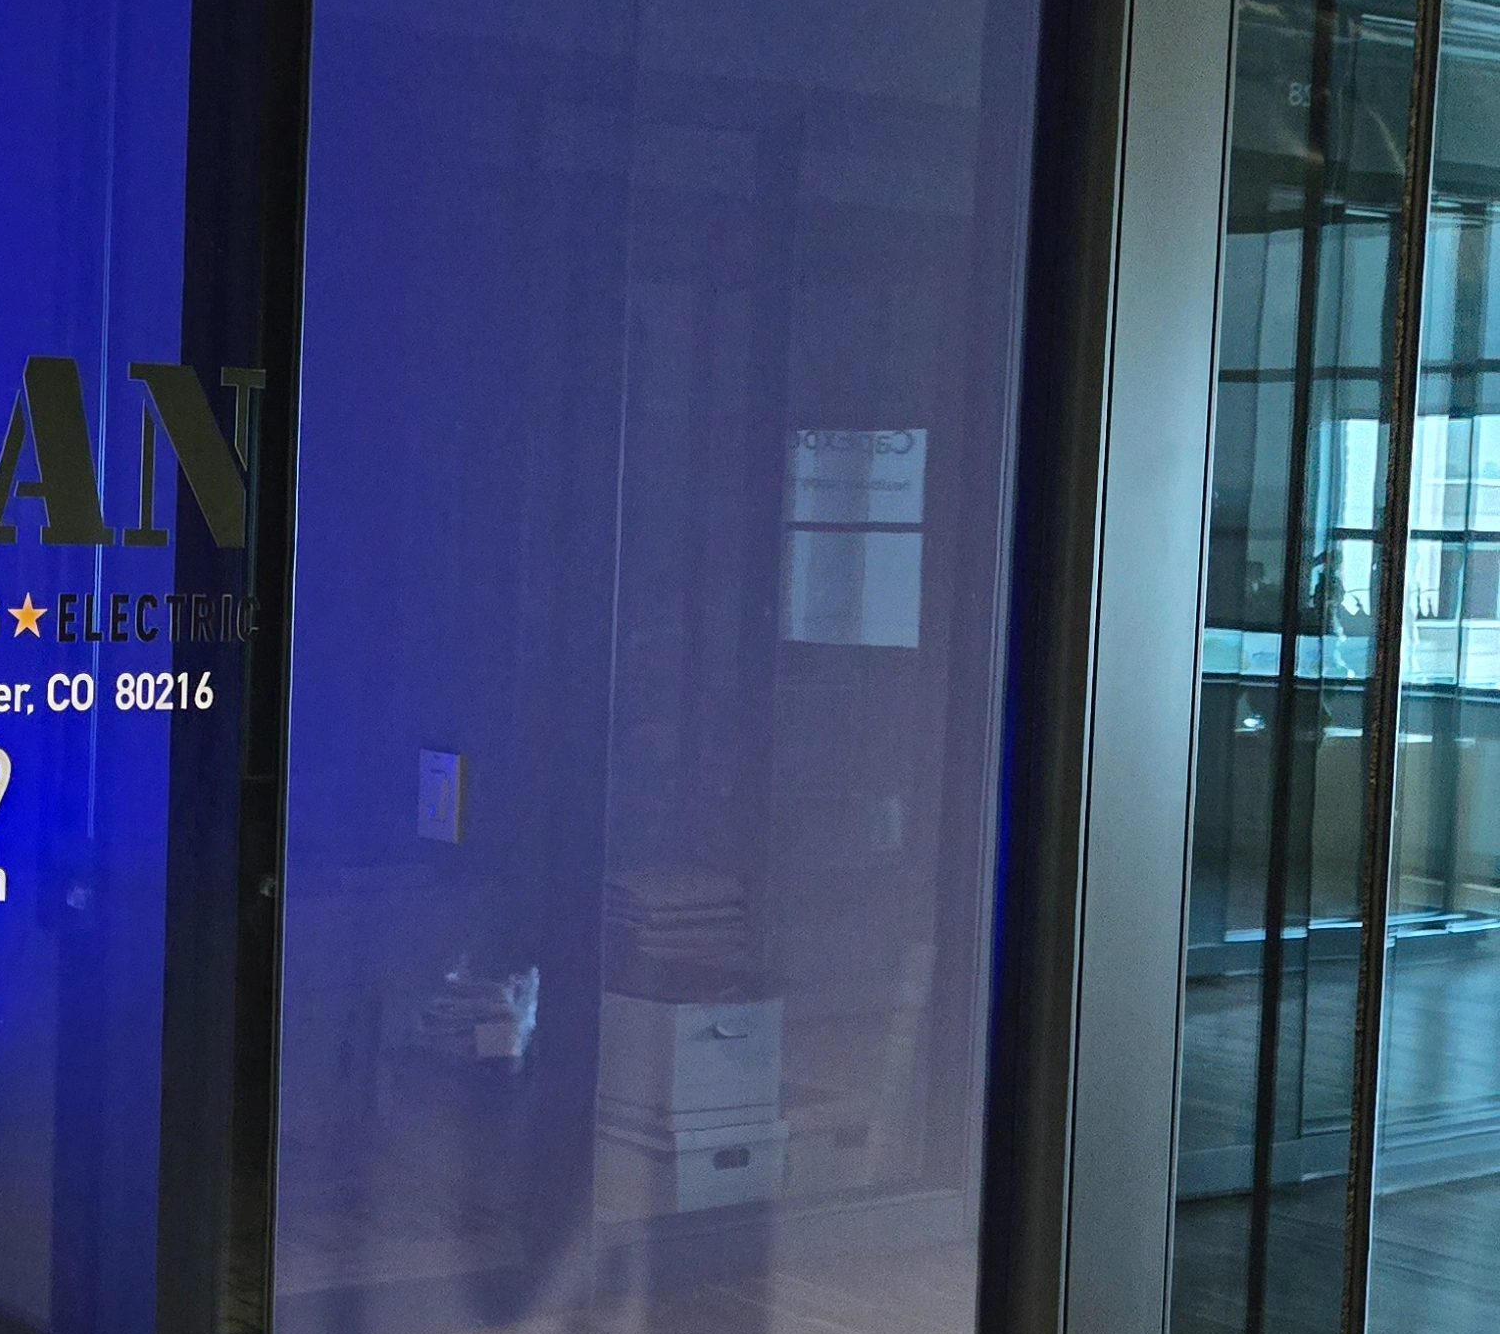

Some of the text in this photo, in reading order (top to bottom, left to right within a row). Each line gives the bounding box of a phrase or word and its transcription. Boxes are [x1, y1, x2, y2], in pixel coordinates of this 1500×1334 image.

[56, 592, 261, 643] ELECTRIC
[46, 673, 96, 712] CO
[114, 671, 215, 711] 80216
